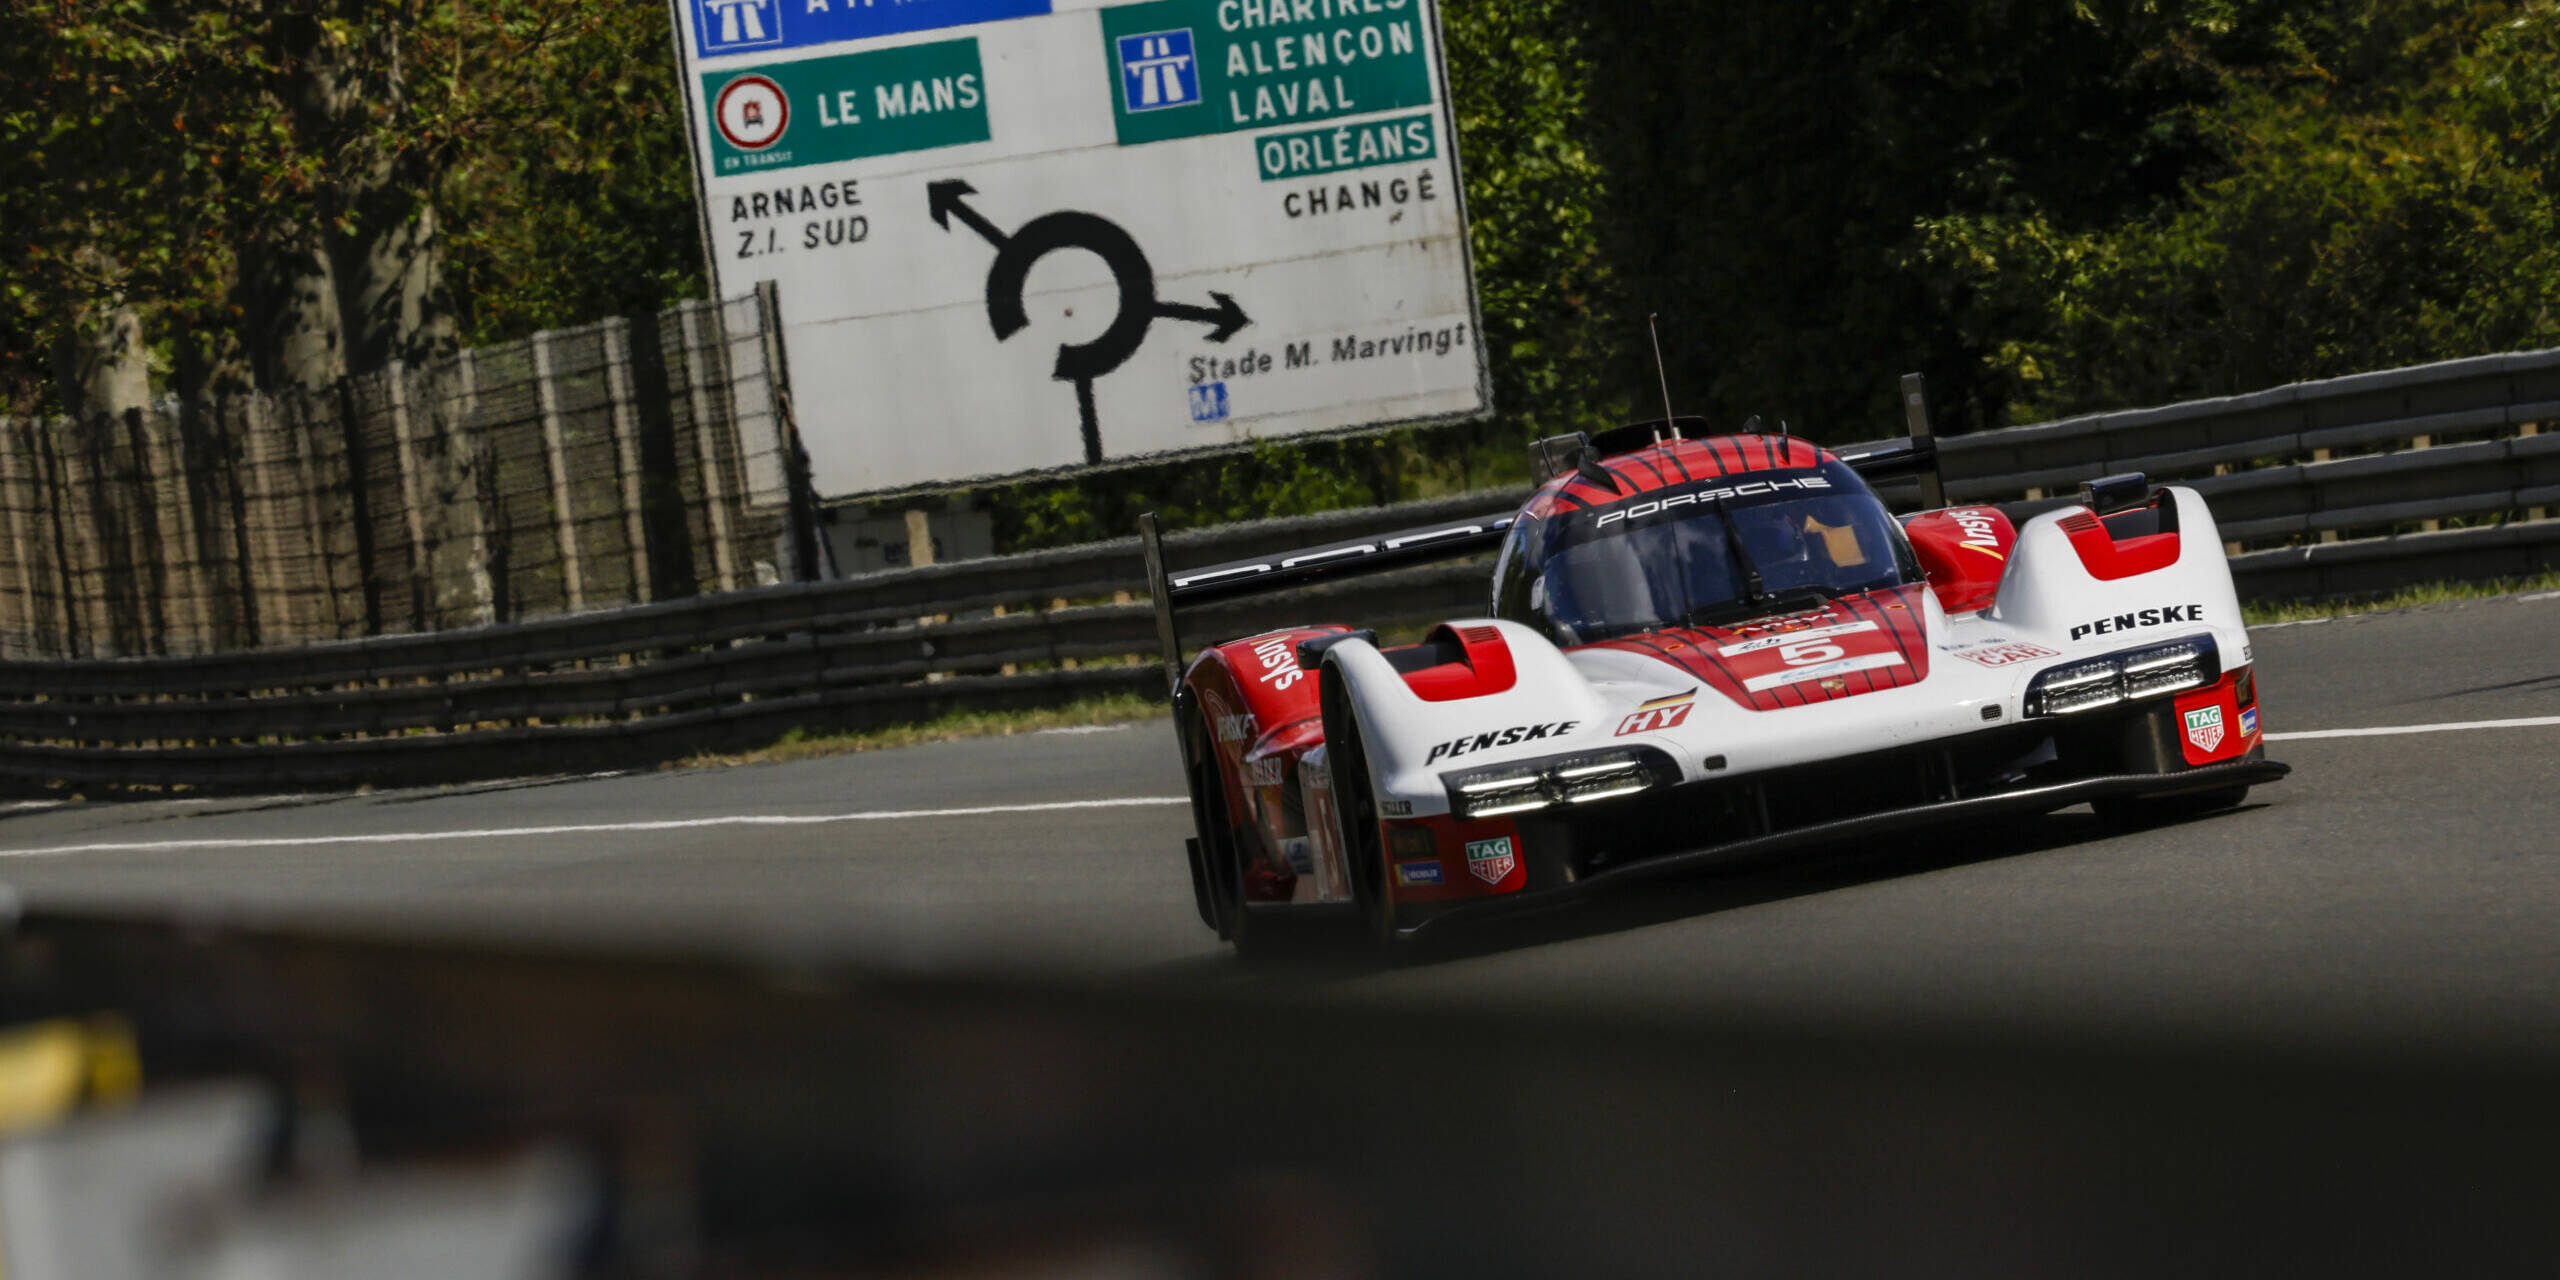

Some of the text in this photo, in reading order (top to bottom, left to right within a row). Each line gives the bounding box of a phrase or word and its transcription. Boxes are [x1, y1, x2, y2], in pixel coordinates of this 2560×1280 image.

[1226, 21, 1414, 77] ALENÇON
[818, 73, 980, 127] LE MANS
[1229, 75, 1354, 124] LAVAL
[1263, 121, 1430, 175] ORLÉANS
[732, 179, 862, 222] ARNAGE
[1284, 168, 1436, 218] CHANGÉ
[737, 215, 869, 259] Z.I. SUD
[1188, 322, 1466, 384] Stade M. Marvingt
[1596, 477, 1831, 528] PORSCHE
[2070, 604, 2203, 641] PENSKE
[1779, 638, 1844, 666] 5
[2188, 708, 2219, 728] TAG
[2189, 726, 2222, 751] HEUER
[1424, 720, 1581, 767] PENSKE
[1470, 841, 1507, 859] TAG
[1472, 857, 1511, 881] HEUER
